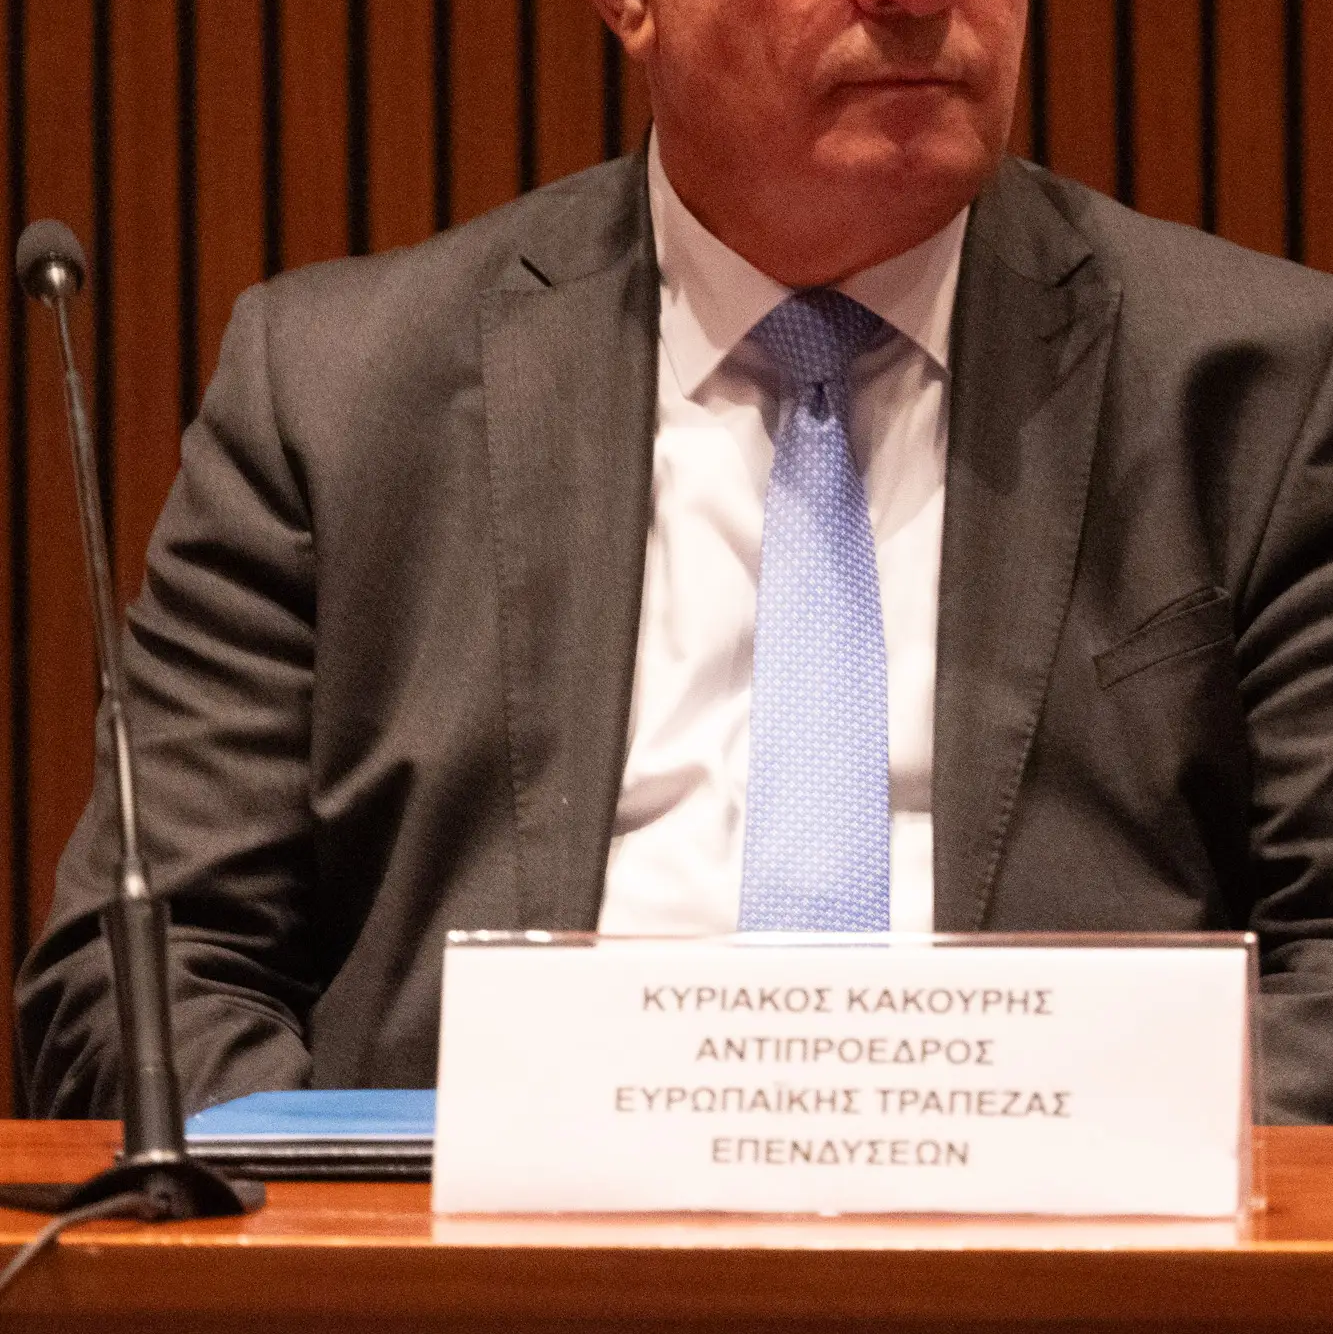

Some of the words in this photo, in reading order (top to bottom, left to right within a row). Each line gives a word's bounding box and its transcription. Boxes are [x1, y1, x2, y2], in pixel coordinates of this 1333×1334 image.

[642, 986, 831, 1013] ΚΥΡΙΑΚΟΣ
[847, 988, 1051, 1016] ΚΑΚΟΥΡΗΣ
[696, 1036, 993, 1066] ΑΝΤΙΠΡΟΕΔΡΟΣ
[614, 1082, 859, 1115] ΕΥΡΩΠΑΪΚΗΣ
[877, 1088, 1070, 1118] ΤΡΑΠΕΖΑΣ
[711, 1137, 969, 1166] ΕΠΕΝΔΥΣΕΩΝ
